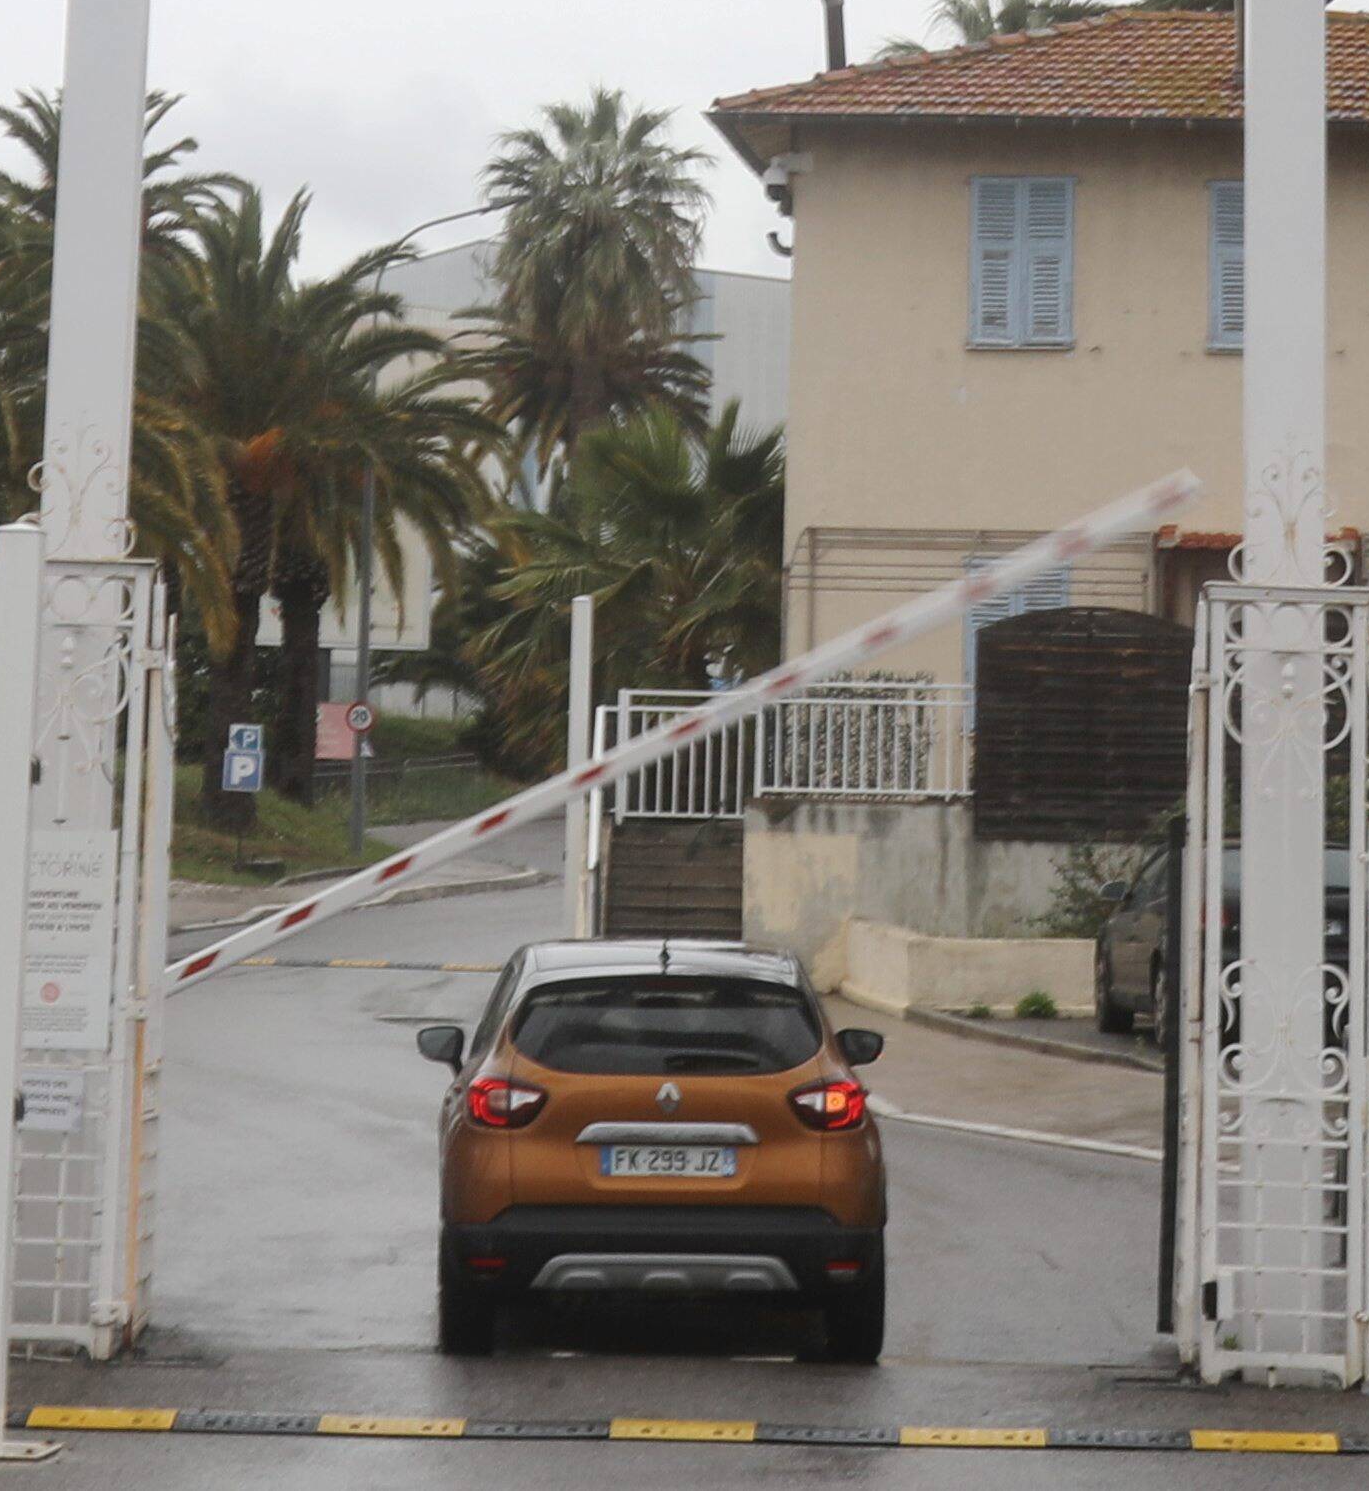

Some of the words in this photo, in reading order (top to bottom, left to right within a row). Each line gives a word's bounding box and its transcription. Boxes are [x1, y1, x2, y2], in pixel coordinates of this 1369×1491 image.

[352, 709, 368, 723] 20
[242, 730, 256, 748] P
[230, 756, 255, 786] P
[614, 1148, 721, 1172] FK-299-JZ
